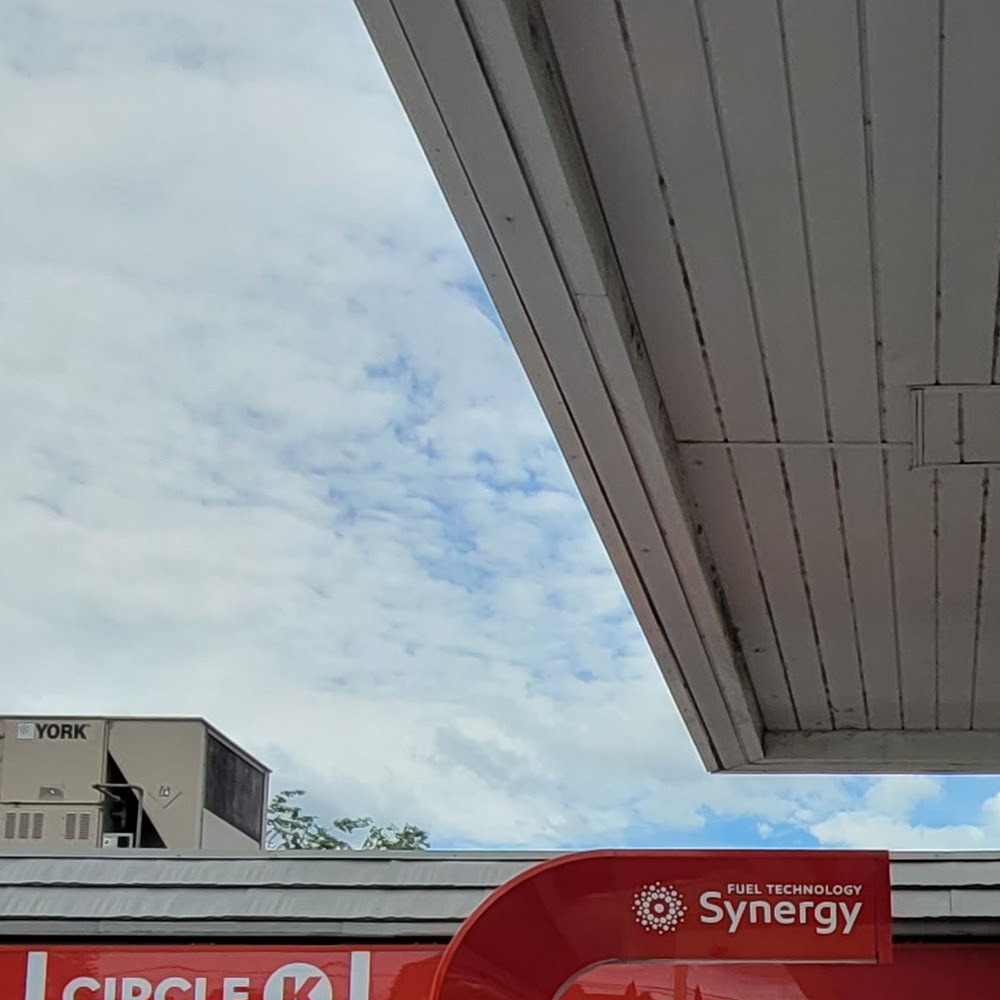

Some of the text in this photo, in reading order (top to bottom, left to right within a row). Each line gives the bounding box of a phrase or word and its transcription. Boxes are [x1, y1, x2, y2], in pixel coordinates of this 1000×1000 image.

[35, 723, 88, 740] YORK
[727, 884, 862, 896] FUEL TECHNOLOGY
[699, 891, 863, 934] Synergy
